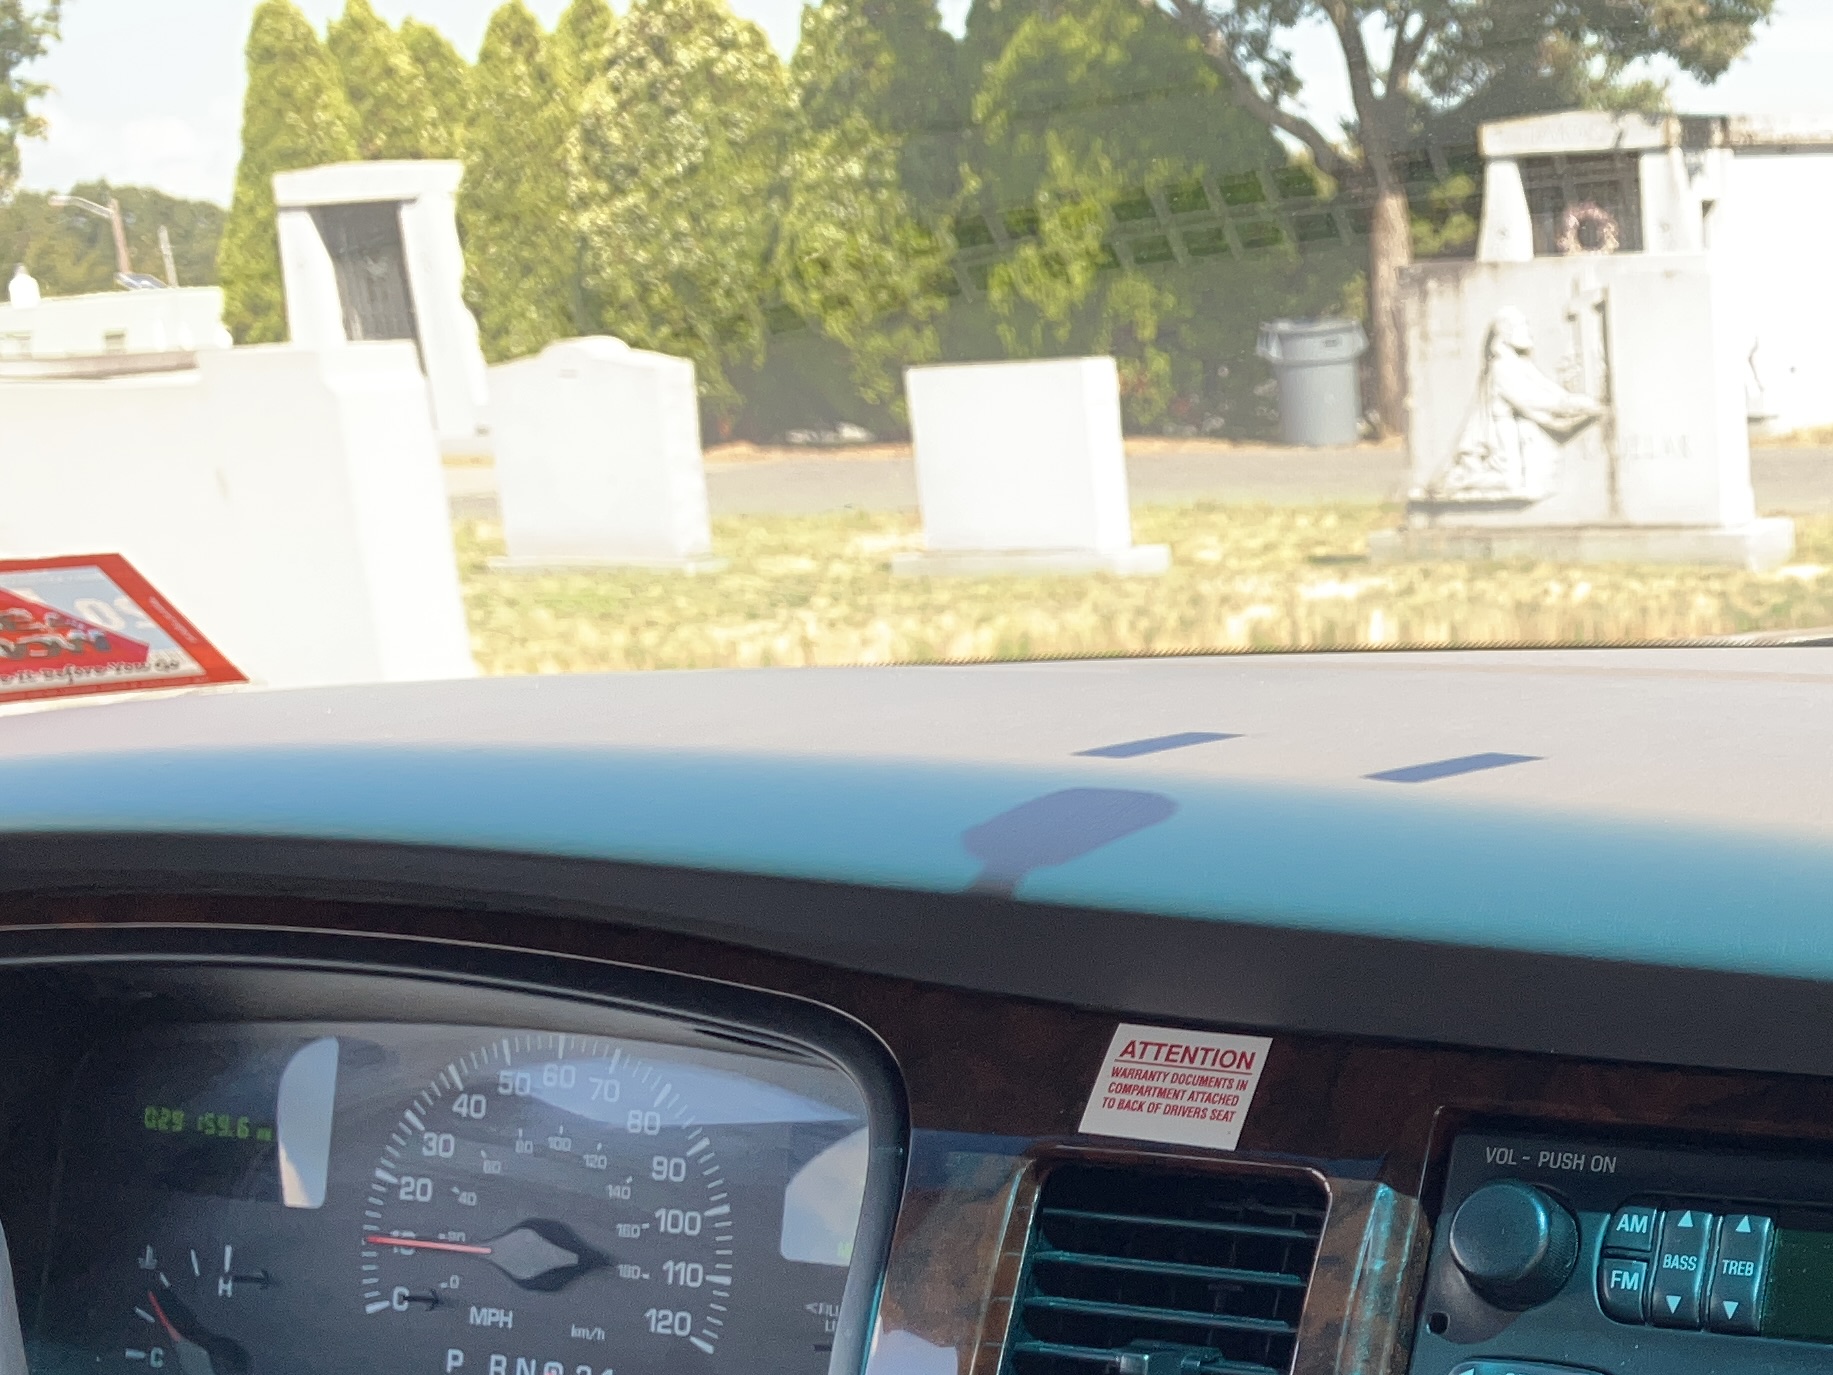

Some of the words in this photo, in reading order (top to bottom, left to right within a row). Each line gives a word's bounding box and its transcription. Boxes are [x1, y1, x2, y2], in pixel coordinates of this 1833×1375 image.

[1119, 1039, 1256, 1070] ATTENTION
[499, 1070, 531, 1096] 50
[543, 1064, 575, 1089] 60
[1111, 1066, 1170, 1083] WARRANTY
[1170, 1072, 1234, 1090] DOCUMENTS
[1236, 1079, 1249, 1091] IN
[588, 1077, 620, 1103] 70
[1108, 1082, 1186, 1101] COMPARTMENT
[1187, 1090, 1240, 1107] ATTACHED
[453, 1094, 486, 1120] 40
[1102, 1096, 1115, 1109] TO
[1116, 1098, 1146, 1113] BACK
[1147, 1102, 1161, 1115] OF
[1162, 1104, 1208, 1120] DRIVERS
[1209, 1108, 1237, 1123] SEAT
[627, 1109, 661, 1136] 80
[422, 1132, 455, 1158] 30
[652, 1156, 686, 1183] 90
[1485, 1146, 1517, 1167] VOL
[1538, 1151, 1585, 1172] PUSH
[1590, 1154, 1617, 1174] ON
[400, 1177, 433, 1202] 20
[654, 1209, 701, 1237] 100
[1616, 1213, 1648, 1235] AM
[662, 1260, 703, 1288] 110
[1662, 1253, 1698, 1272] BASS
[1722, 1258, 1755, 1277] TREB
[1610, 1269, 1640, 1291] FM
[470, 1305, 513, 1329] MPH
[644, 1308, 692, 1337] 120
[150, 1346, 164, 1368] C
[446, 1348, 464, 1373] P
